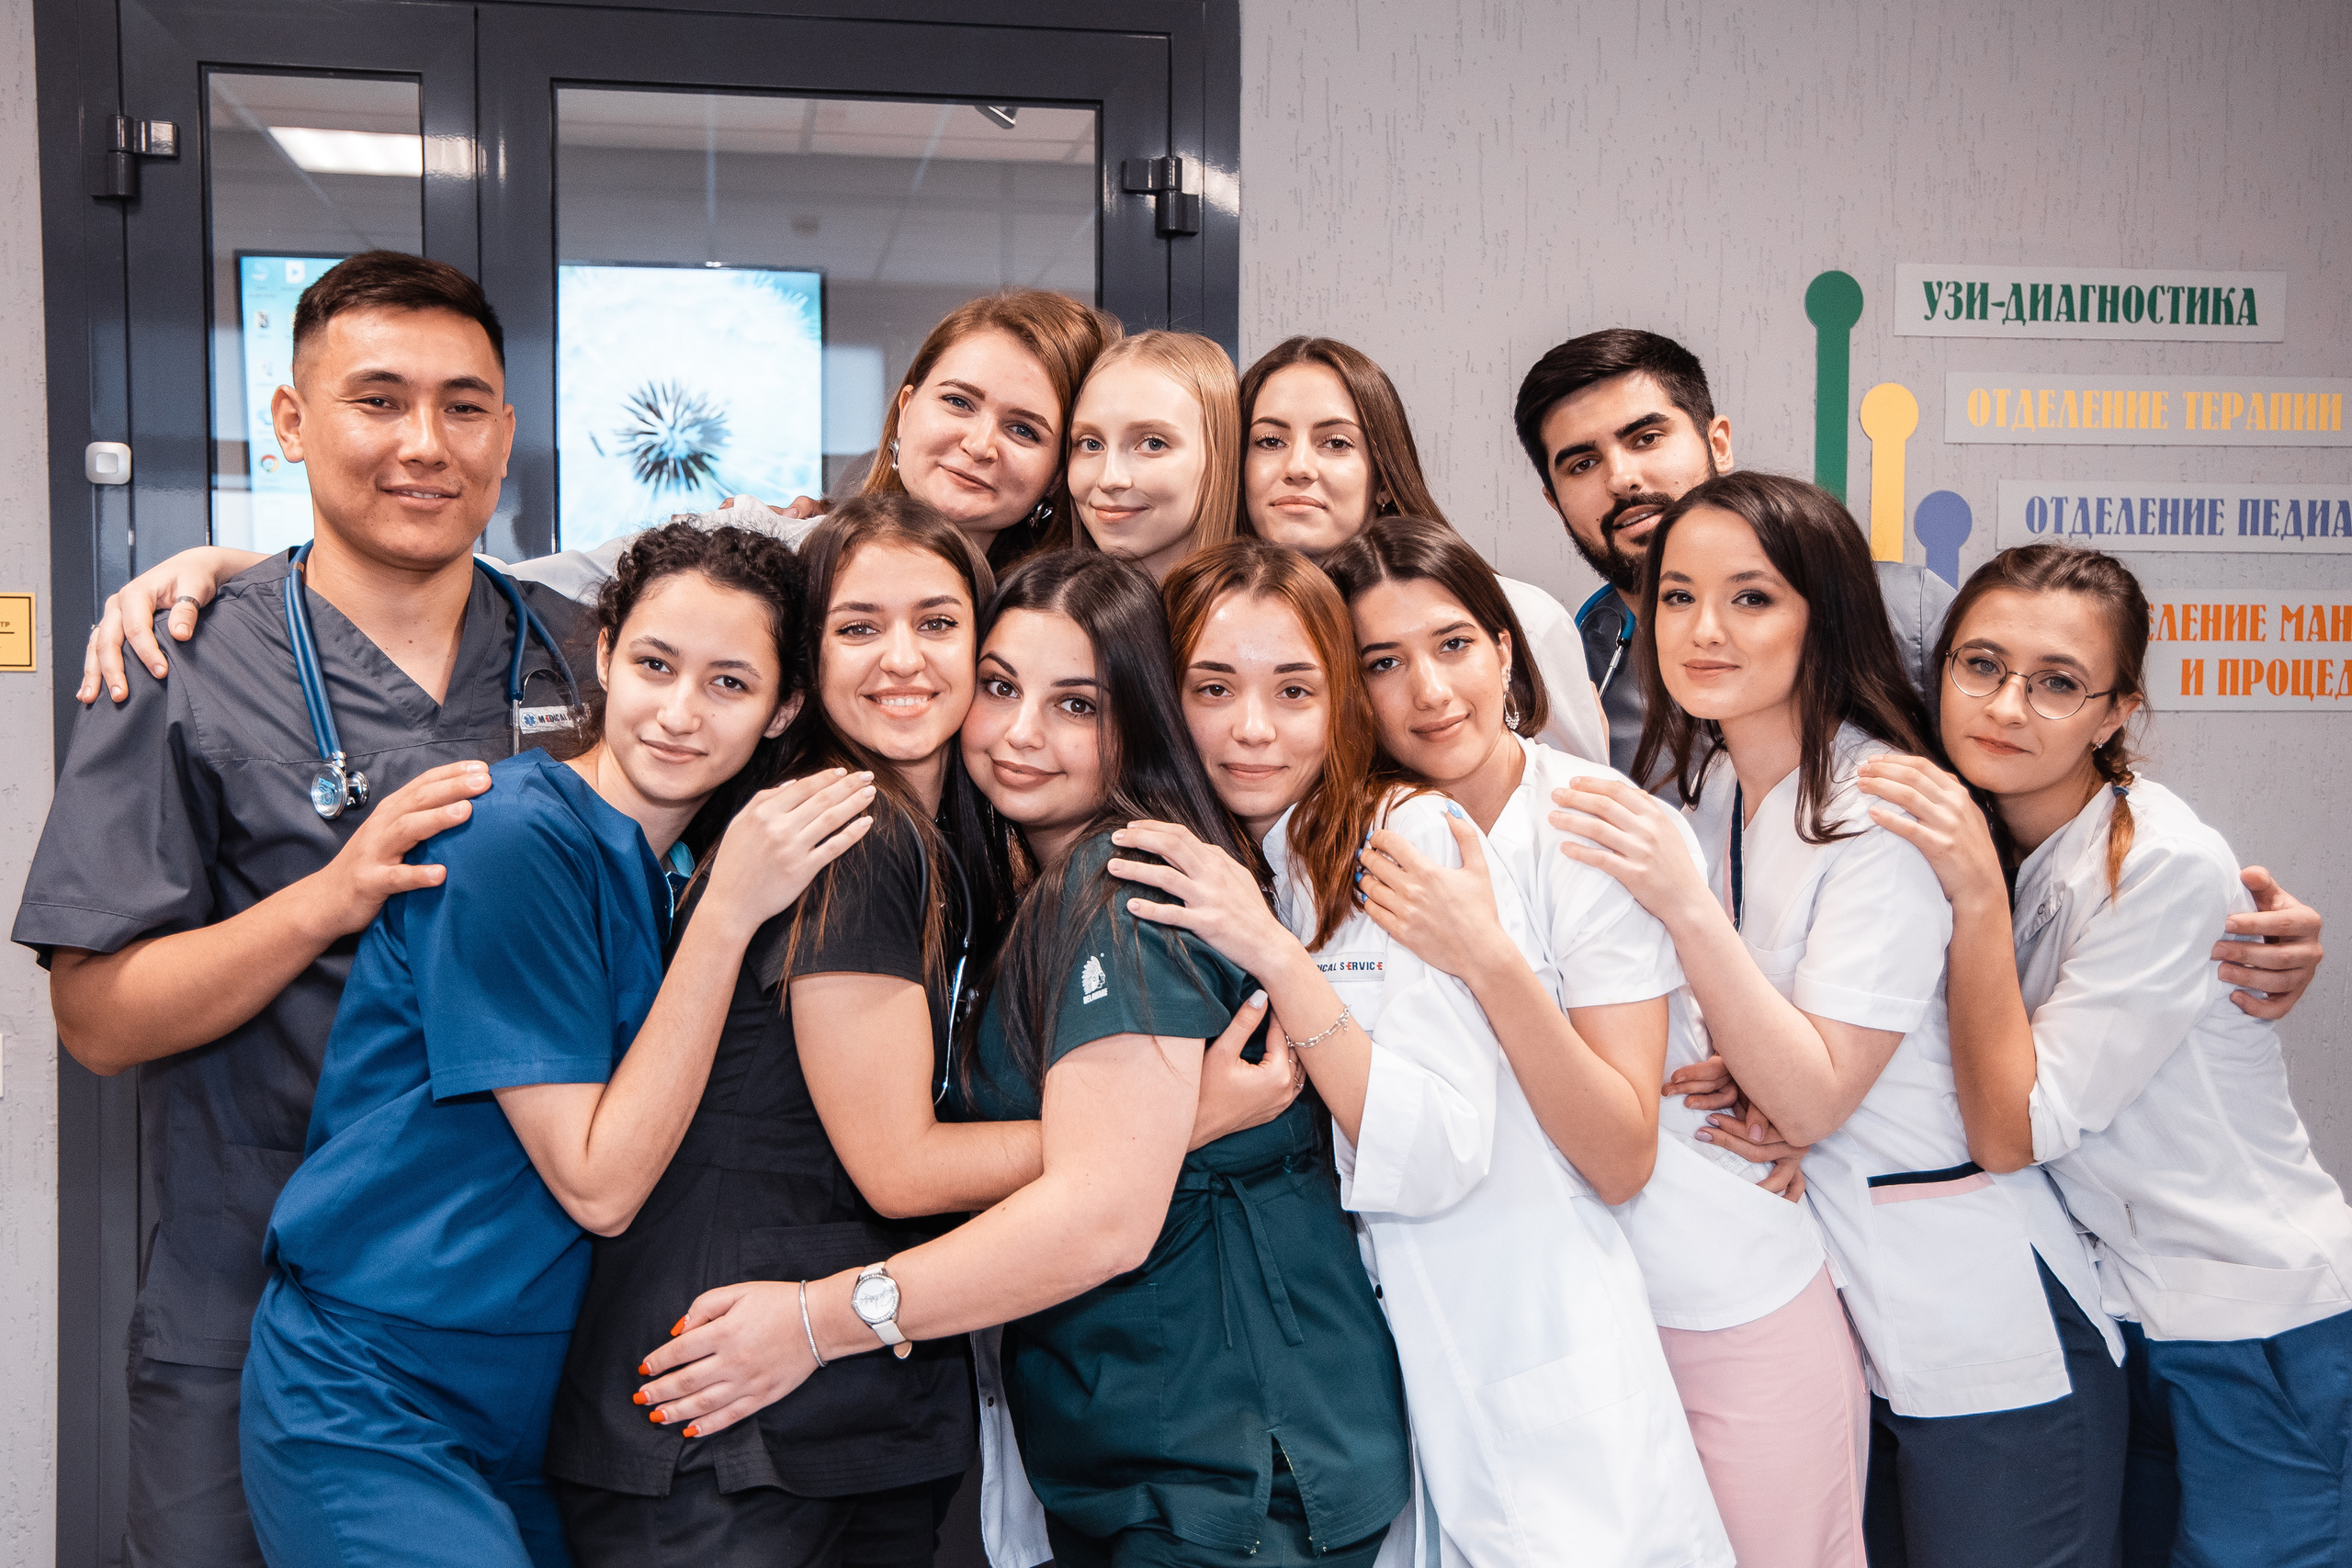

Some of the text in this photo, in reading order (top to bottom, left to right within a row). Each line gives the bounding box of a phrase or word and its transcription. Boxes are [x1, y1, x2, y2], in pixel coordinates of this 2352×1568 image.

[1923, 280, 2258, 326] УЗИ-ДИАГНОСТИКА
[1967, 388, 2343, 432] ОТДЕЛЕНИЕ ТЕРАПИИ
[2025, 495, 2224, 539] ОТДЕЛЕНИЕ
[2180, 659, 2204, 696] И
[1340, 962, 1383, 970] SERVICE
